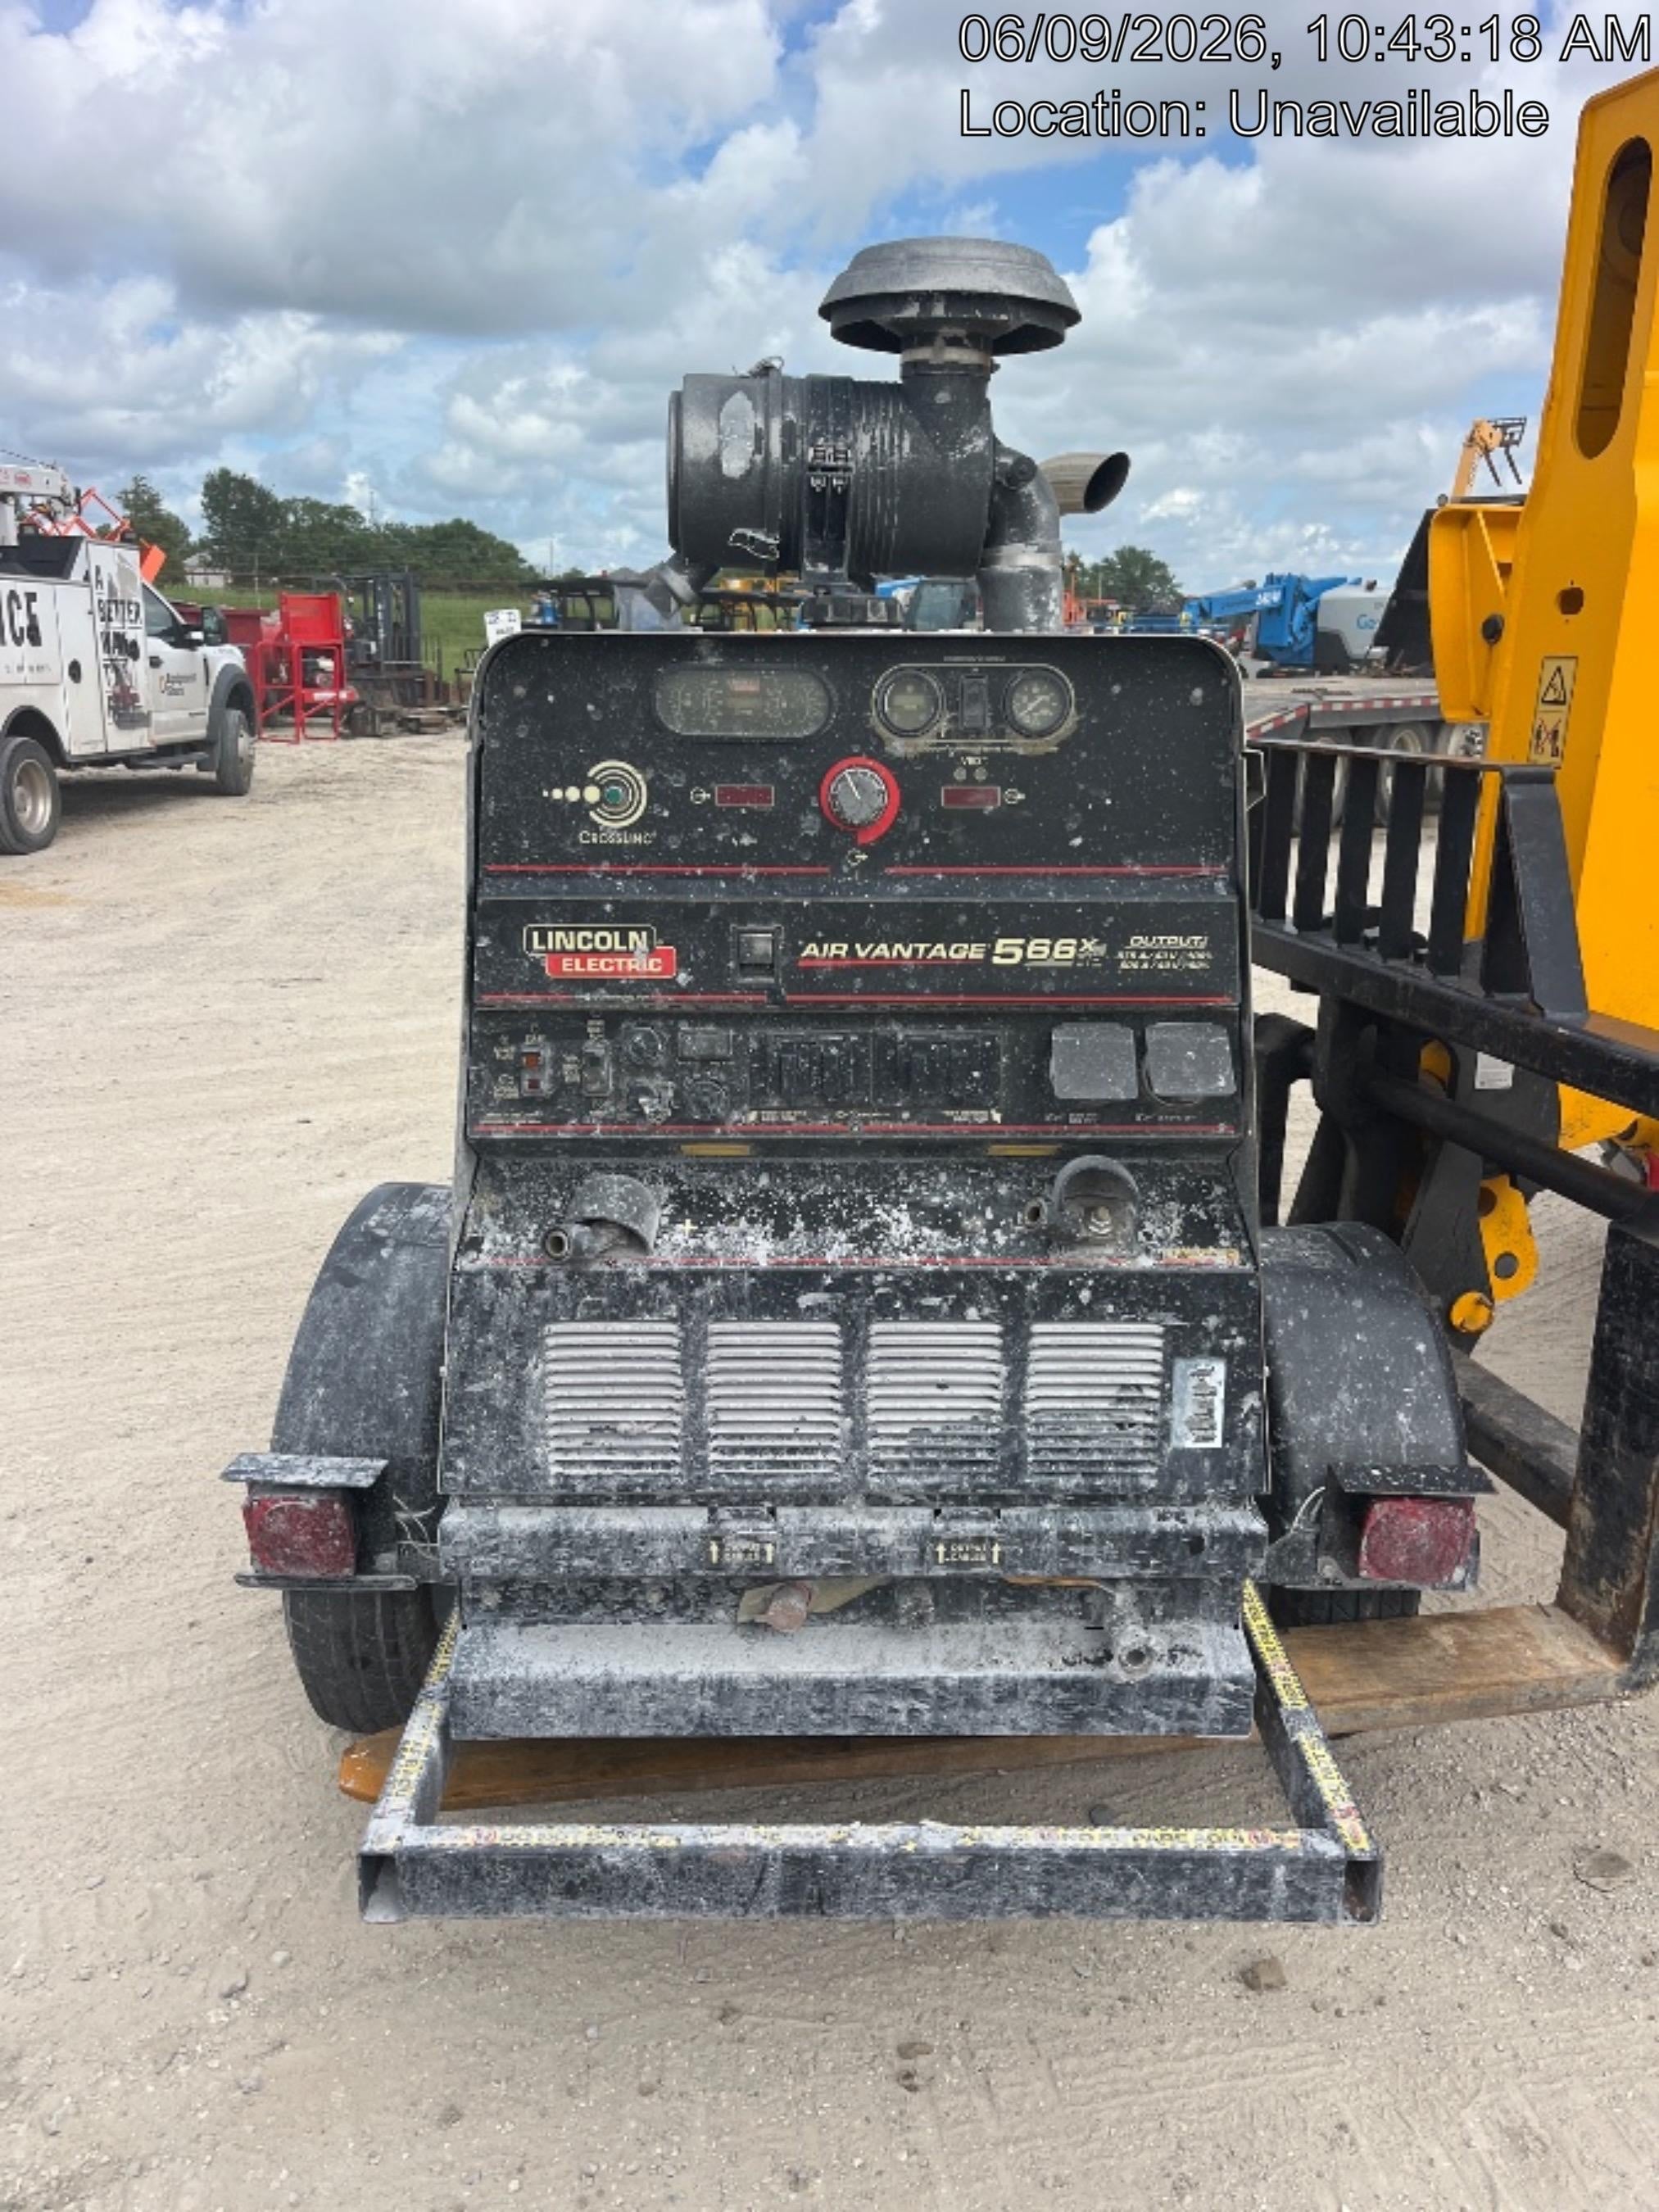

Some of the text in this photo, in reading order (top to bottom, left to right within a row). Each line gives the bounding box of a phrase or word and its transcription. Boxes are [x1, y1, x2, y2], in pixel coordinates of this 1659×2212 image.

[533, 931, 648, 951] LINCOLN
[800, 942, 849, 959] AIR
[854, 942, 986, 960] VANTAGE
[562, 957, 663, 972] ELECTRIC
